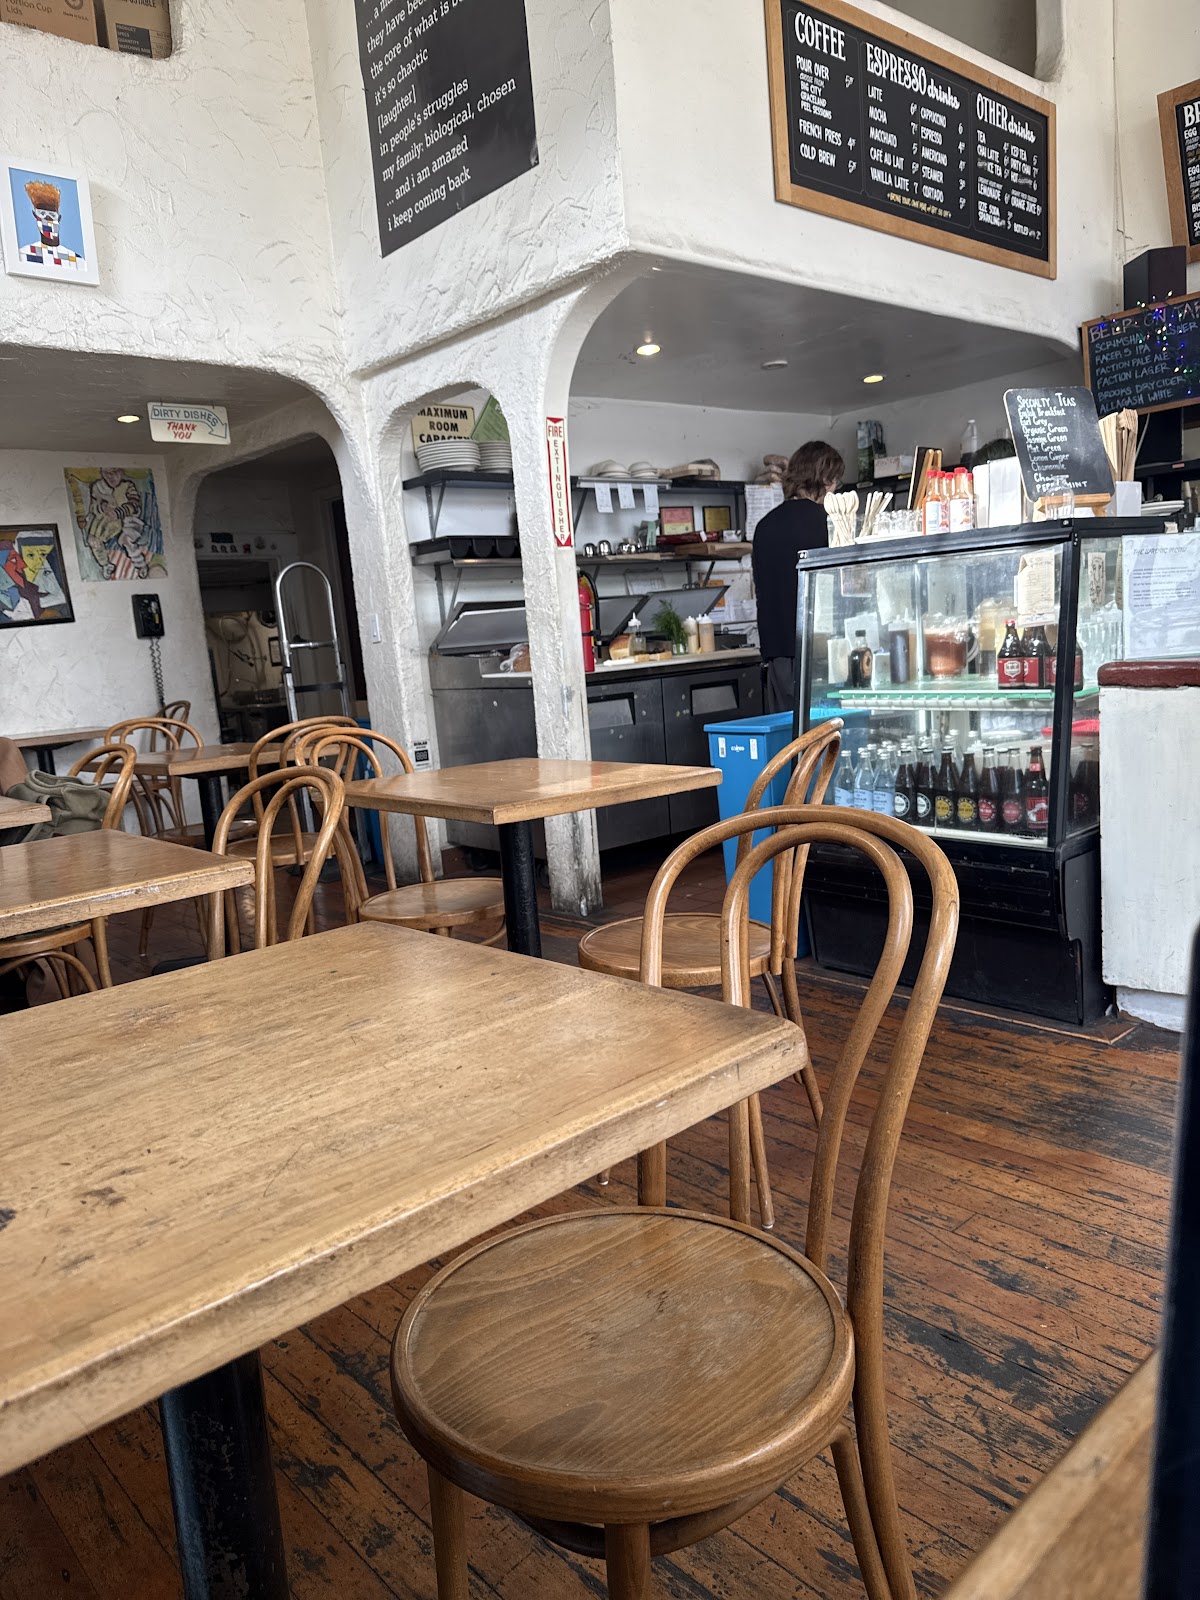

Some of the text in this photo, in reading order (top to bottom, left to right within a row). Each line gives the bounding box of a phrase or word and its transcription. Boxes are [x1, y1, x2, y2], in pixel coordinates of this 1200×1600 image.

[6, 5, 23, 15] Lids
[36, 2, 53, 14] Cup
[366, 28, 385, 54] they
[384, 9, 406, 36] have
[370, 0, 450, 79] the core of what is
[795, 11, 847, 61] COFFEE
[374, 48, 429, 106] it's so chaotic
[796, 54, 813, 74] POUR
[814, 62, 830, 81] OVER
[866, 42, 961, 110] ESPRESSO drinks
[800, 80, 822, 97] BIG CITY
[867, 84, 883, 102] LATTE
[800, 90, 827, 107] GRACELAND
[800, 100, 812, 112] PEEL
[377, 84, 417, 135] [laughter]
[379, 78, 469, 157] in people's struggles
[868, 105, 887, 124] MOCHA
[976, 92, 1036, 143] OTHER drinks
[382, 77, 517, 182] my family: biological, chosen
[799, 118, 823, 140] FRENCH
[824, 127, 842, 147] PRESS
[920, 126, 943, 145] ESPRESSO
[958, 122, 964, 135] 6
[977, 129, 986, 144] TEA
[1183, 126, 1198, 140] EGG
[869, 126, 898, 148] MACCHIATO
[912, 142, 918, 155] 5
[799, 142, 816, 160] COLD
[818, 148, 836, 168] BREW
[884, 152, 892, 166] AU
[892, 155, 904, 171] LAIT
[921, 145, 948, 167] AMERICANO
[987, 147, 1000, 163] LATTE
[1019, 148, 1027, 162] TEA
[394, 176, 411, 200] and
[410, 173, 416, 188] i
[416, 166, 431, 184] am
[431, 134, 469, 173] amazed
[921, 165, 944, 184] STEAMER
[994, 163, 1003, 178] TEA
[1010, 170, 1019, 183] HOT
[1187, 164, 1200, 177] EGG
[870, 166, 893, 187] VANILLA
[894, 174, 910, 192] LATTE
[913, 182, 919, 194] 7
[387, 165, 471, 232] i keep coming back
[922, 184, 944, 203] CORTADO
[977, 182, 1001, 201] LEMONADE
[1010, 195, 1026, 211] ORANGE
[1095, 343, 1151, 365] RACER 5 IPA
[1095, 351, 1170, 377] FACTION PALE ALE
[1097, 362, 1171, 390] FACTION LAGER
[1098, 386, 1132, 402] BROOKS
[1100, 387, 1173, 415] ALLAGASH WHITE
[153, 408, 219, 427] DIRTY DISHES
[166, 421, 197, 431] THANK
[429, 421, 459, 432] ROOM
[172, 431, 193, 439] YOU
[548, 425, 563, 438] FIRE
[1021, 422, 1069, 436] Organic Green
[1046, 432, 1068, 443] Green
[1040, 441, 1062, 453] Green
[1048, 451, 1070, 462] Ginger
[553, 439, 566, 541] EXTINGUISHER
